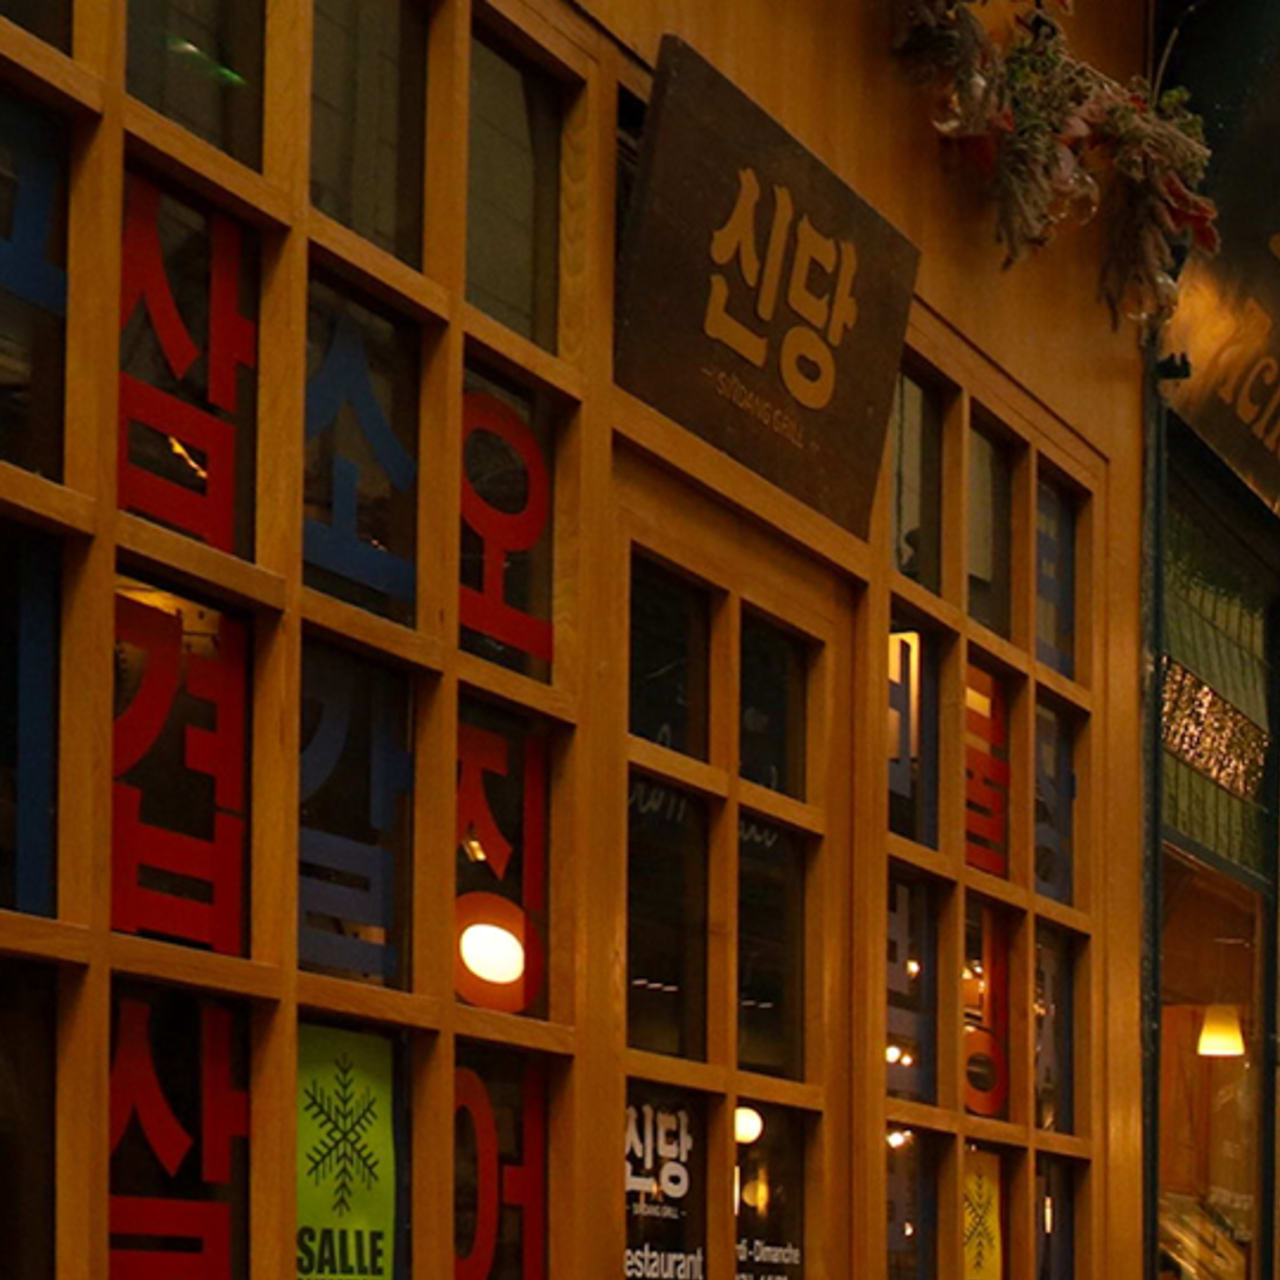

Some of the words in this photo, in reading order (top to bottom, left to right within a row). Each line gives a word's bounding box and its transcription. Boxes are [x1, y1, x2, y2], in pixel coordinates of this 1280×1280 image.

[704, 167, 858, 410] 신당
[297, 1227, 384, 1277] SALLE
[624, 1243, 703, 1280] estaurant
[754, 1240, 800, 1265] Dimanche
